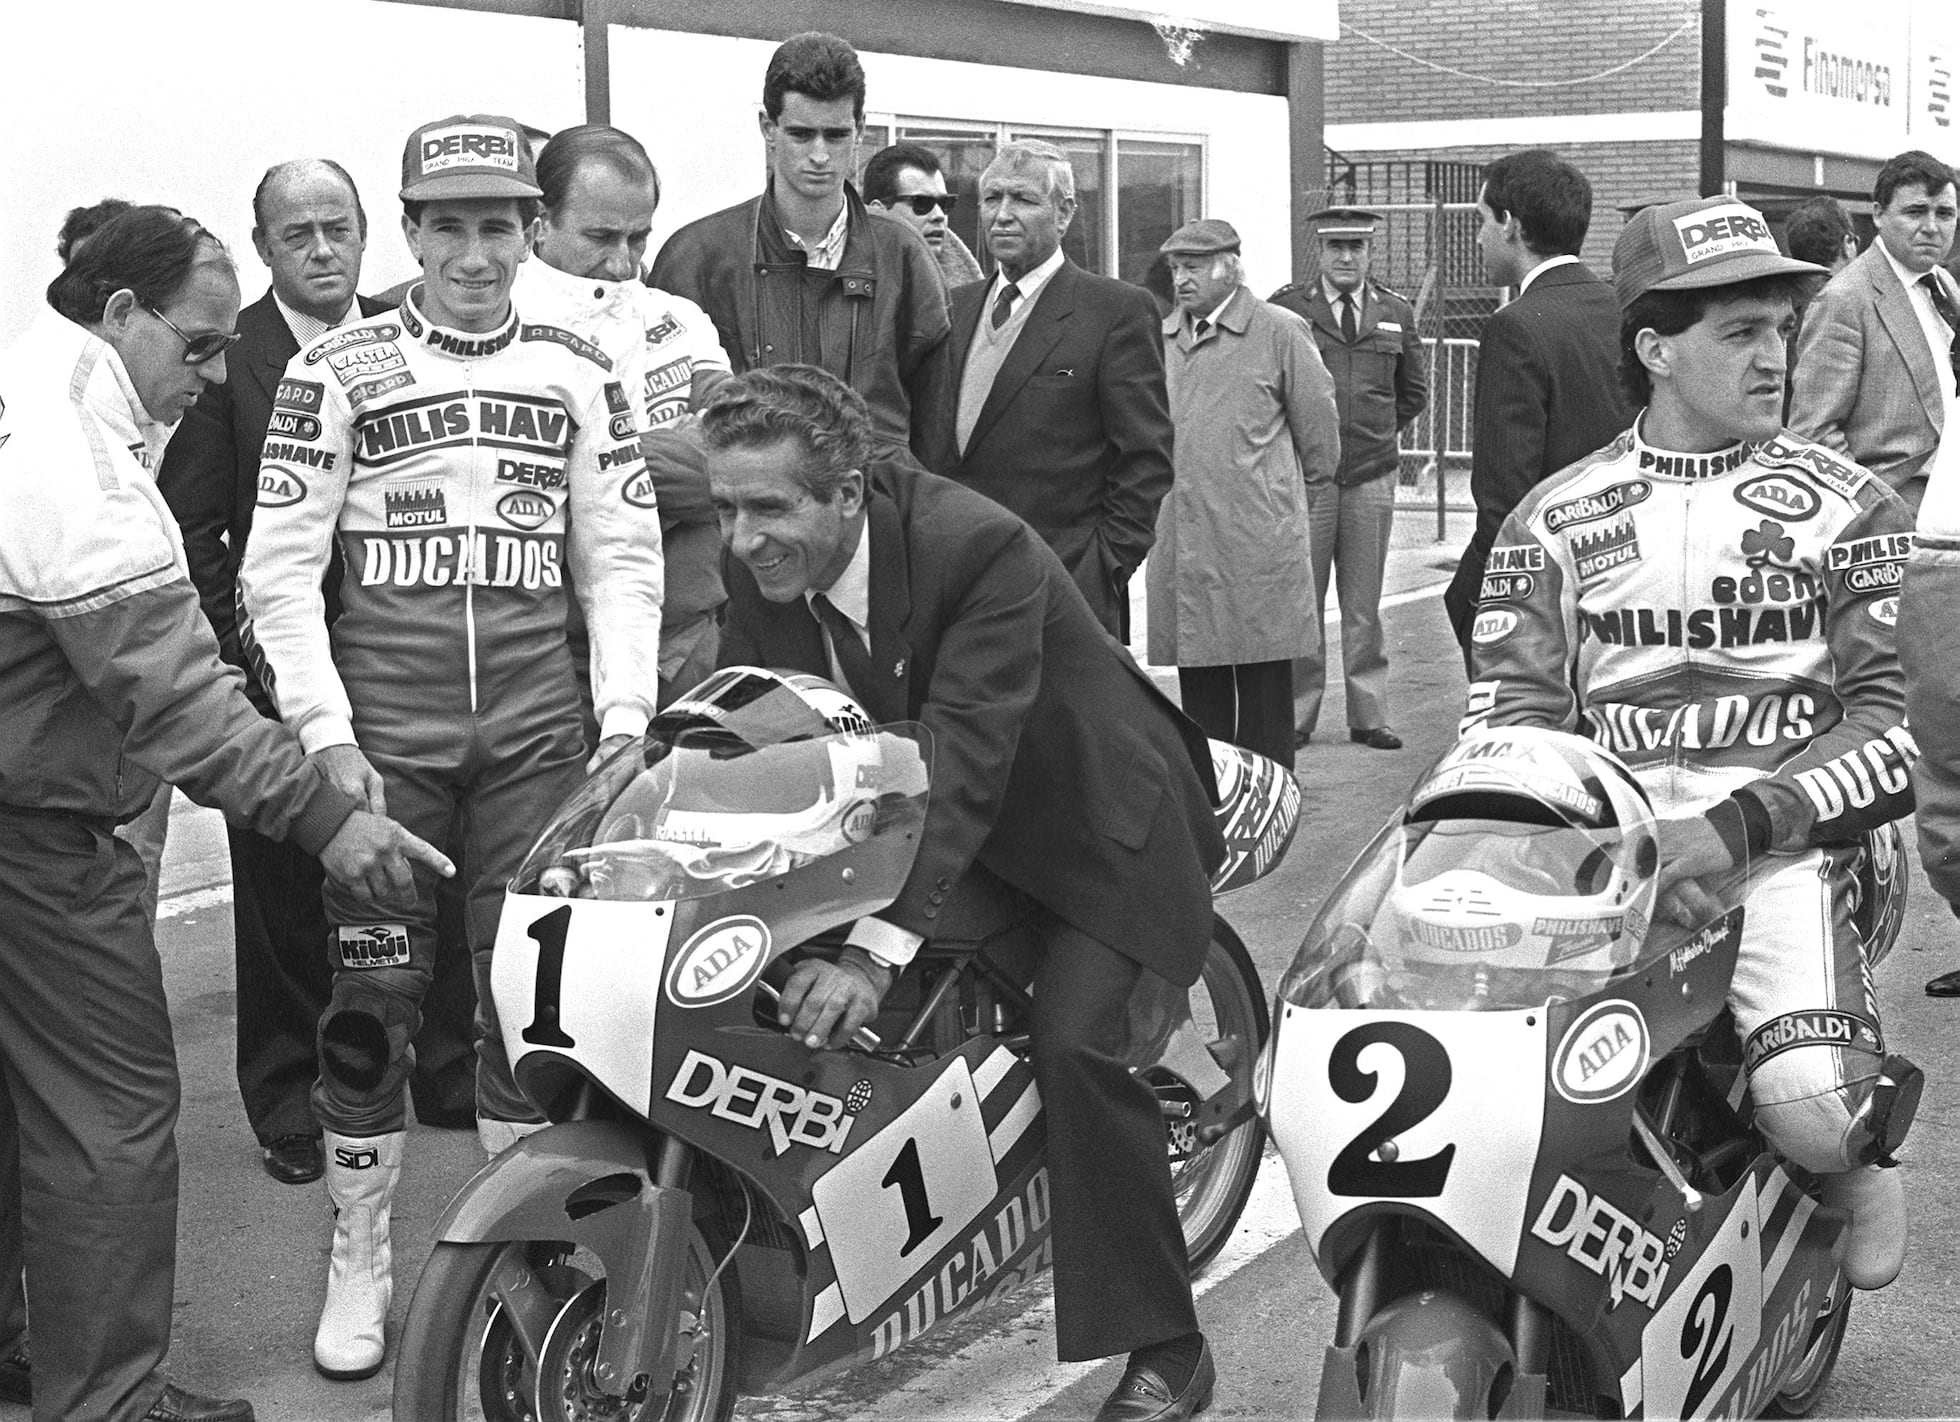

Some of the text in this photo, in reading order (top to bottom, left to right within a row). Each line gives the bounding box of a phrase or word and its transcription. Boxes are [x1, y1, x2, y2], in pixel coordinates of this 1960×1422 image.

[494, 157, 514, 167] TEAM
[1691, 245, 1724, 260] GRAND
[531, 327, 608, 363] RICARD
[351, 374, 408, 401] RICARD
[506, 499, 549, 519] ADA
[1748, 485, 1806, 510] ADA
[388, 510, 446, 527] MOTUL
[361, 533, 563, 590] DUCADOS
[1580, 544, 1638, 577] MOTUL
[1473, 616, 1510, 637] ADA
[351, 956, 399, 967] HELMETS
[521, 904, 576, 1049] 1
[690, 934, 754, 991] ADA
[1577, 1020, 1634, 1083] ADA
[1327, 1021, 1457, 1199] 2
[881, 1136, 944, 1259] 1
[1680, 1262, 1735, 1422] 2
